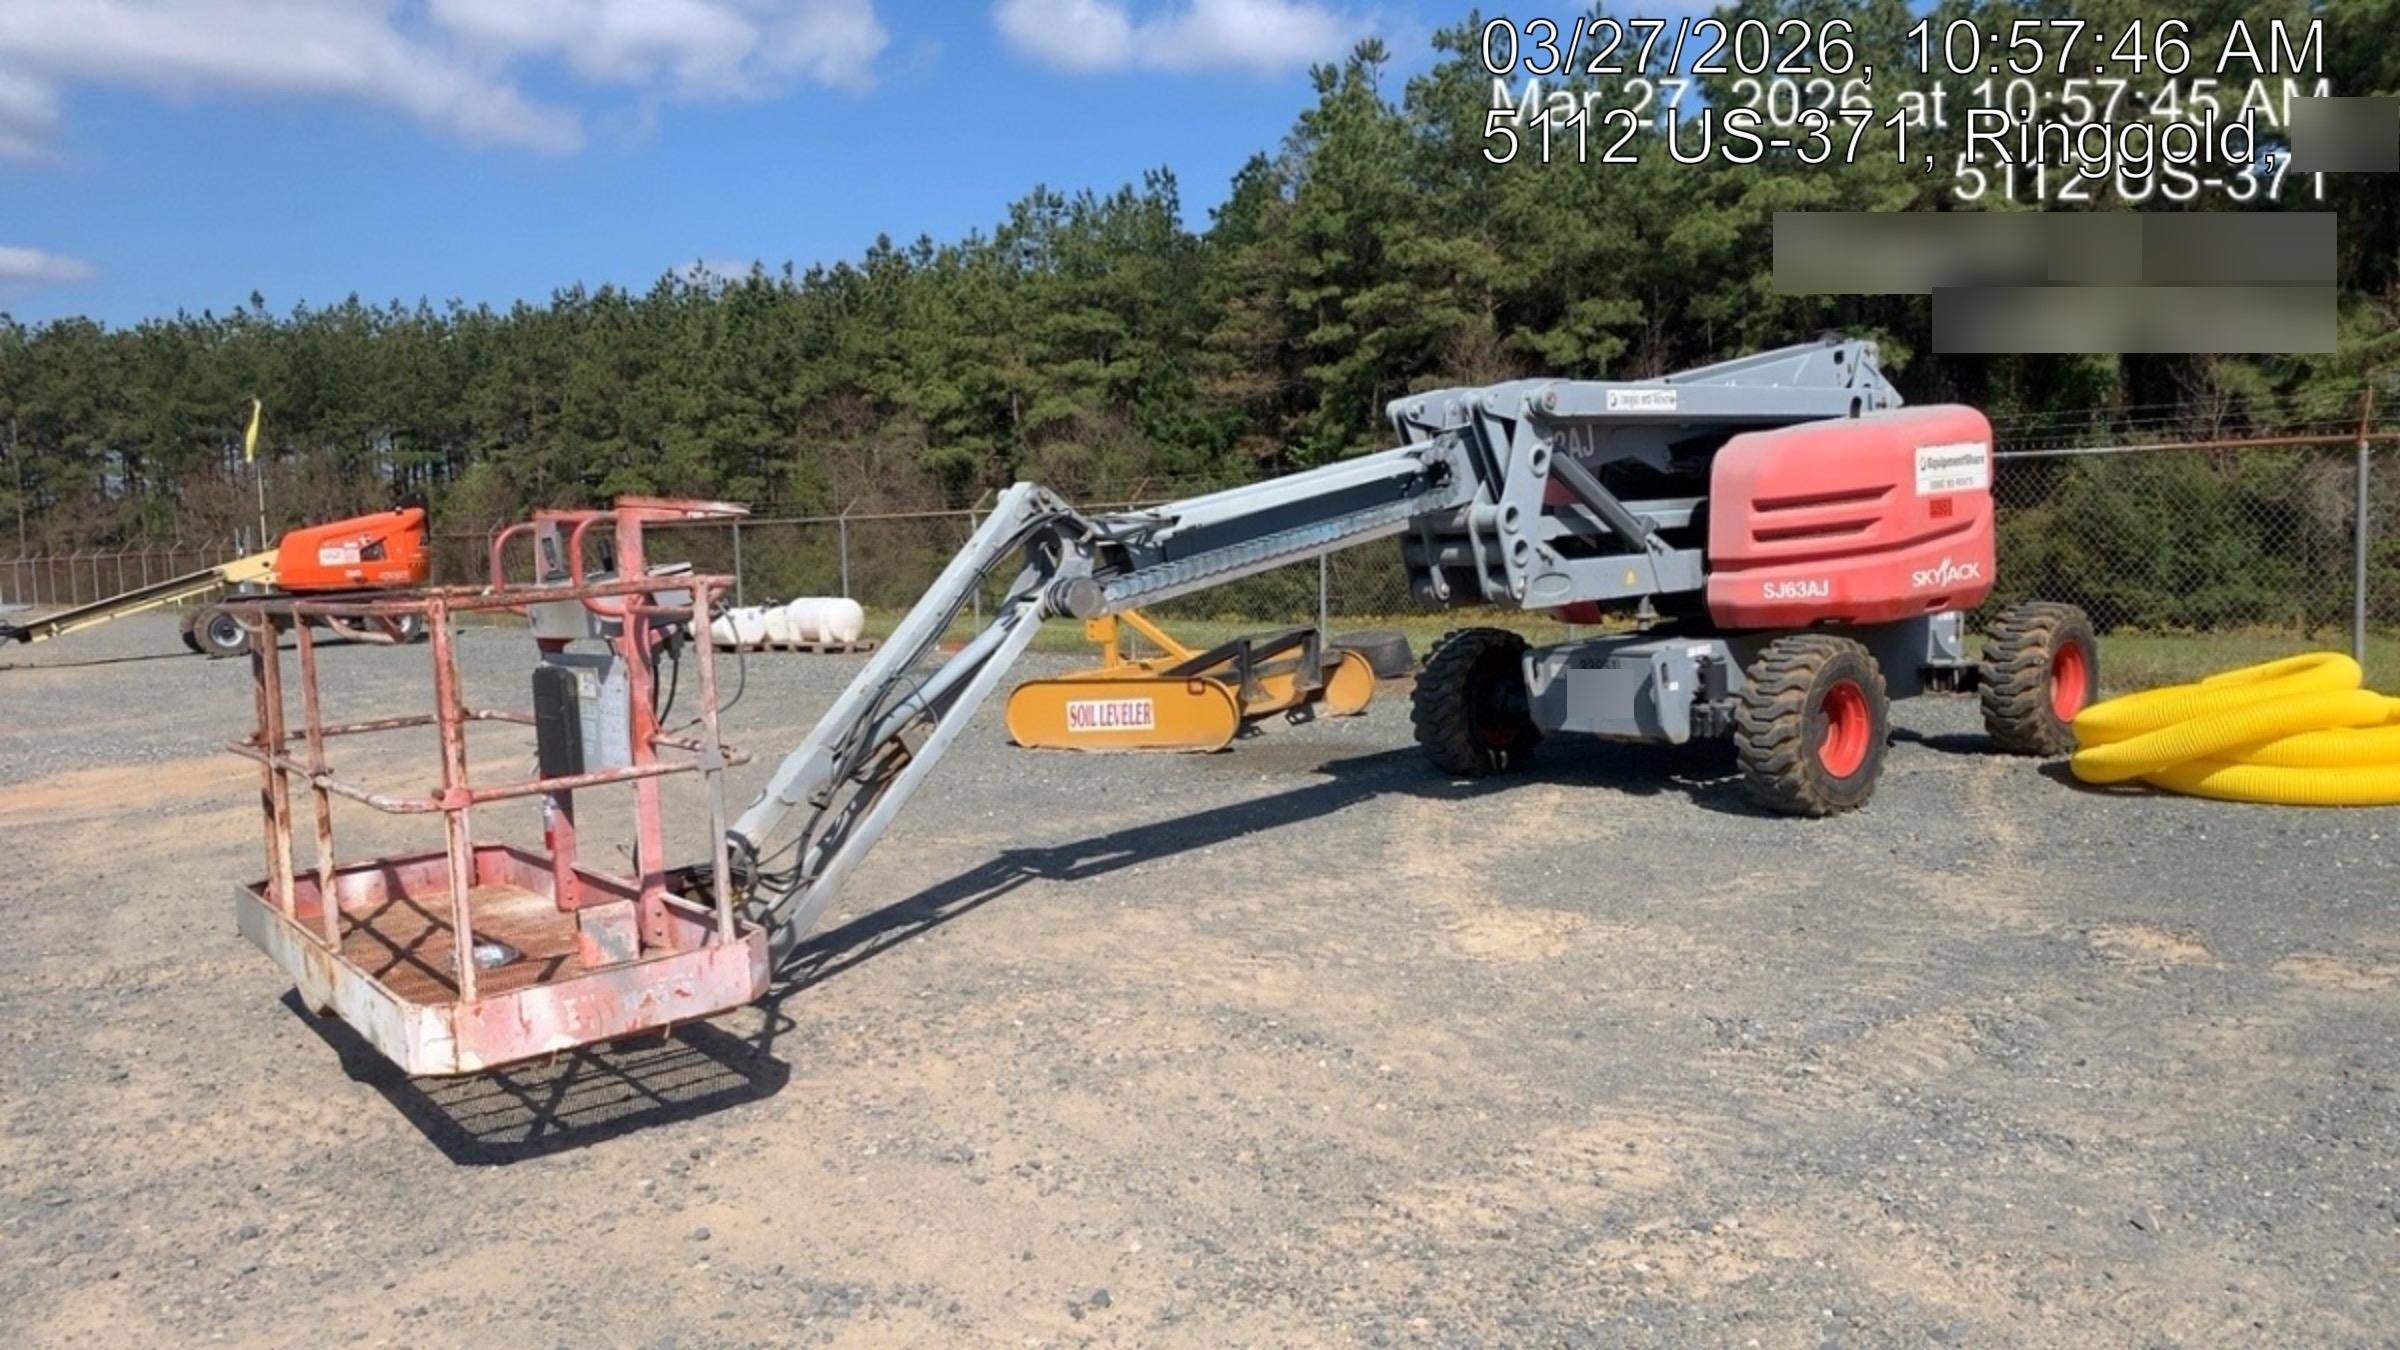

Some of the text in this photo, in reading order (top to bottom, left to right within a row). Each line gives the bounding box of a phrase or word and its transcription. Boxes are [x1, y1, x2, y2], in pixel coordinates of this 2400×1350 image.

[1911, 557, 1980, 588] SKYJACK
[1763, 579, 1829, 599] SJ63AJ
[1070, 702, 1152, 728] SOIL LEVELER
